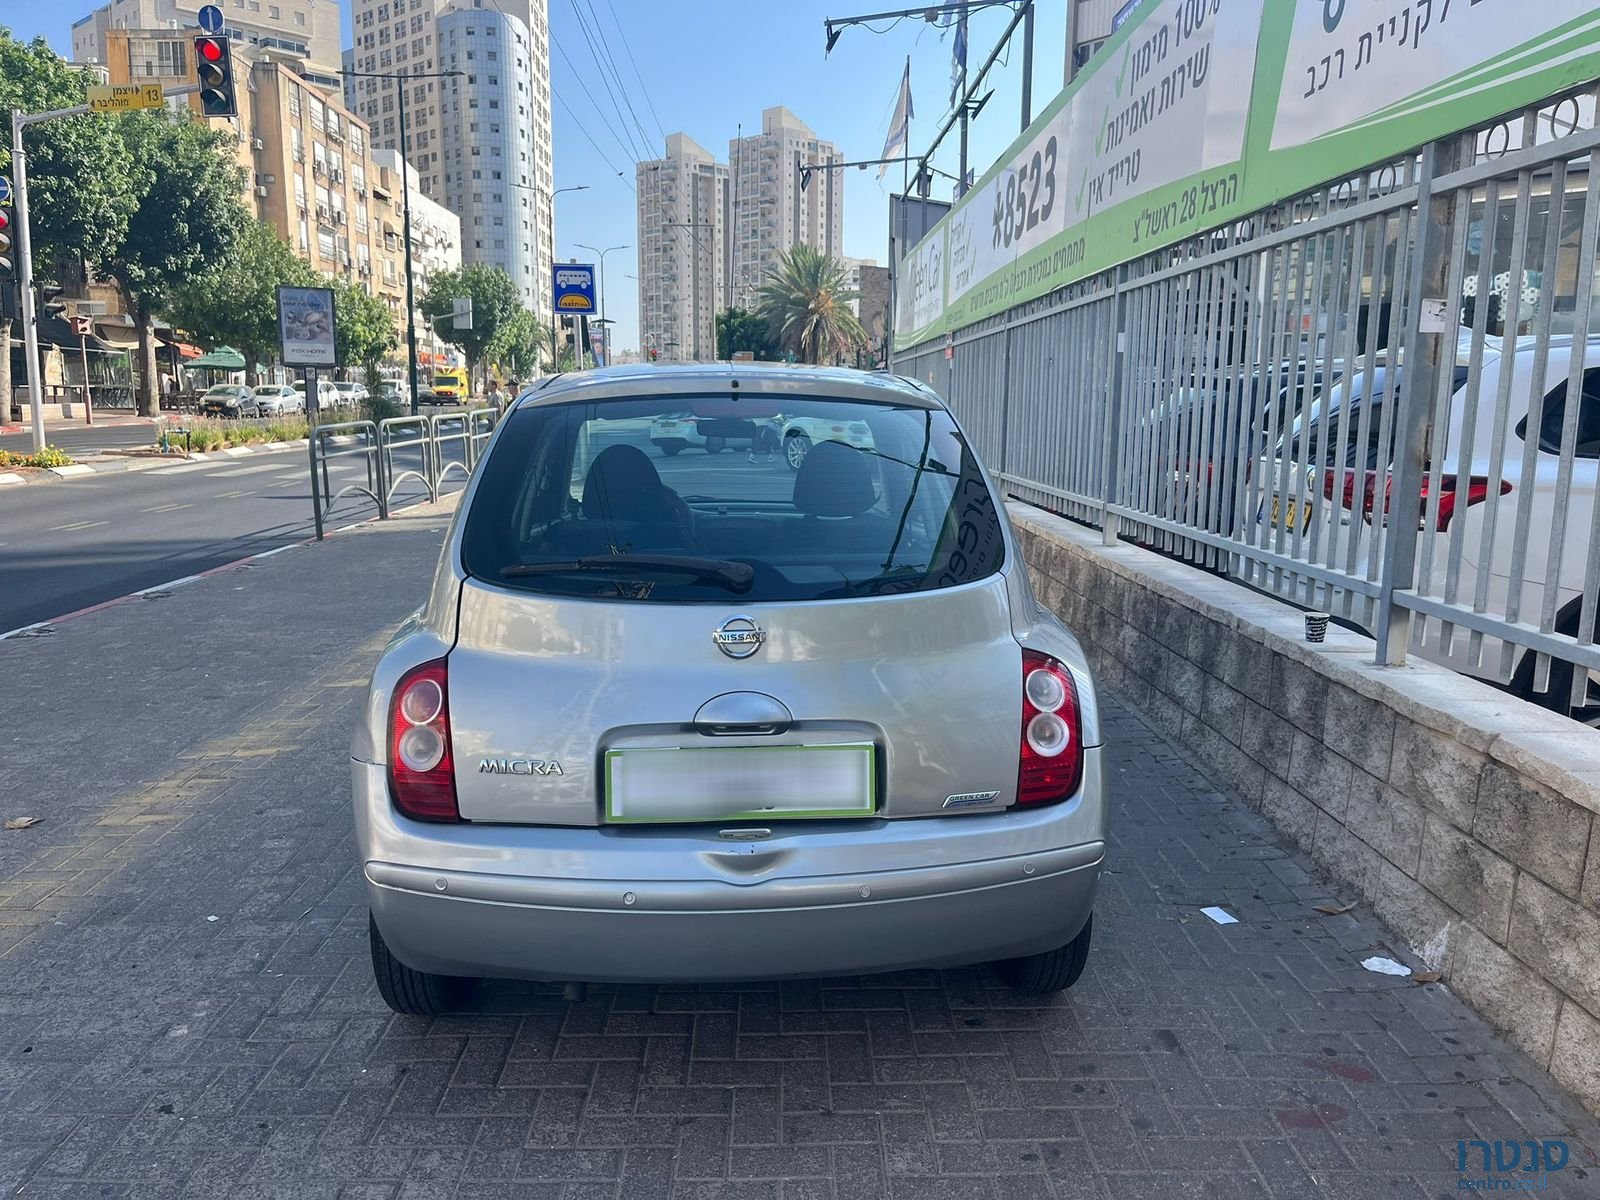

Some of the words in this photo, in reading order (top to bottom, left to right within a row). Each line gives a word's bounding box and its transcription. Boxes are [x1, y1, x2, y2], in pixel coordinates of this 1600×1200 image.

[1130, 24, 1169, 97] מימון
[1158, 42, 1210, 116] שירות
[1303, 48, 1345, 99] רכב
[96, 97, 129, 108] מוהליבר
[112, 86, 135, 98] ויצמן
[145, 89, 159, 102] 13
[1104, 87, 1156, 154] ואמינות
[1107, 148, 1141, 197] טרייד
[1087, 172, 1106, 219] אין
[1179, 186, 1198, 224] 28
[1200, 173, 1238, 215] הרצל
[1026, 255, 1052, 288] במכירת
[1052, 236, 1086, 274] מתמחים
[718, 633, 760, 641] NISSAN
[479, 758, 564, 776] MICRA
[949, 794, 974, 802] GREEN
